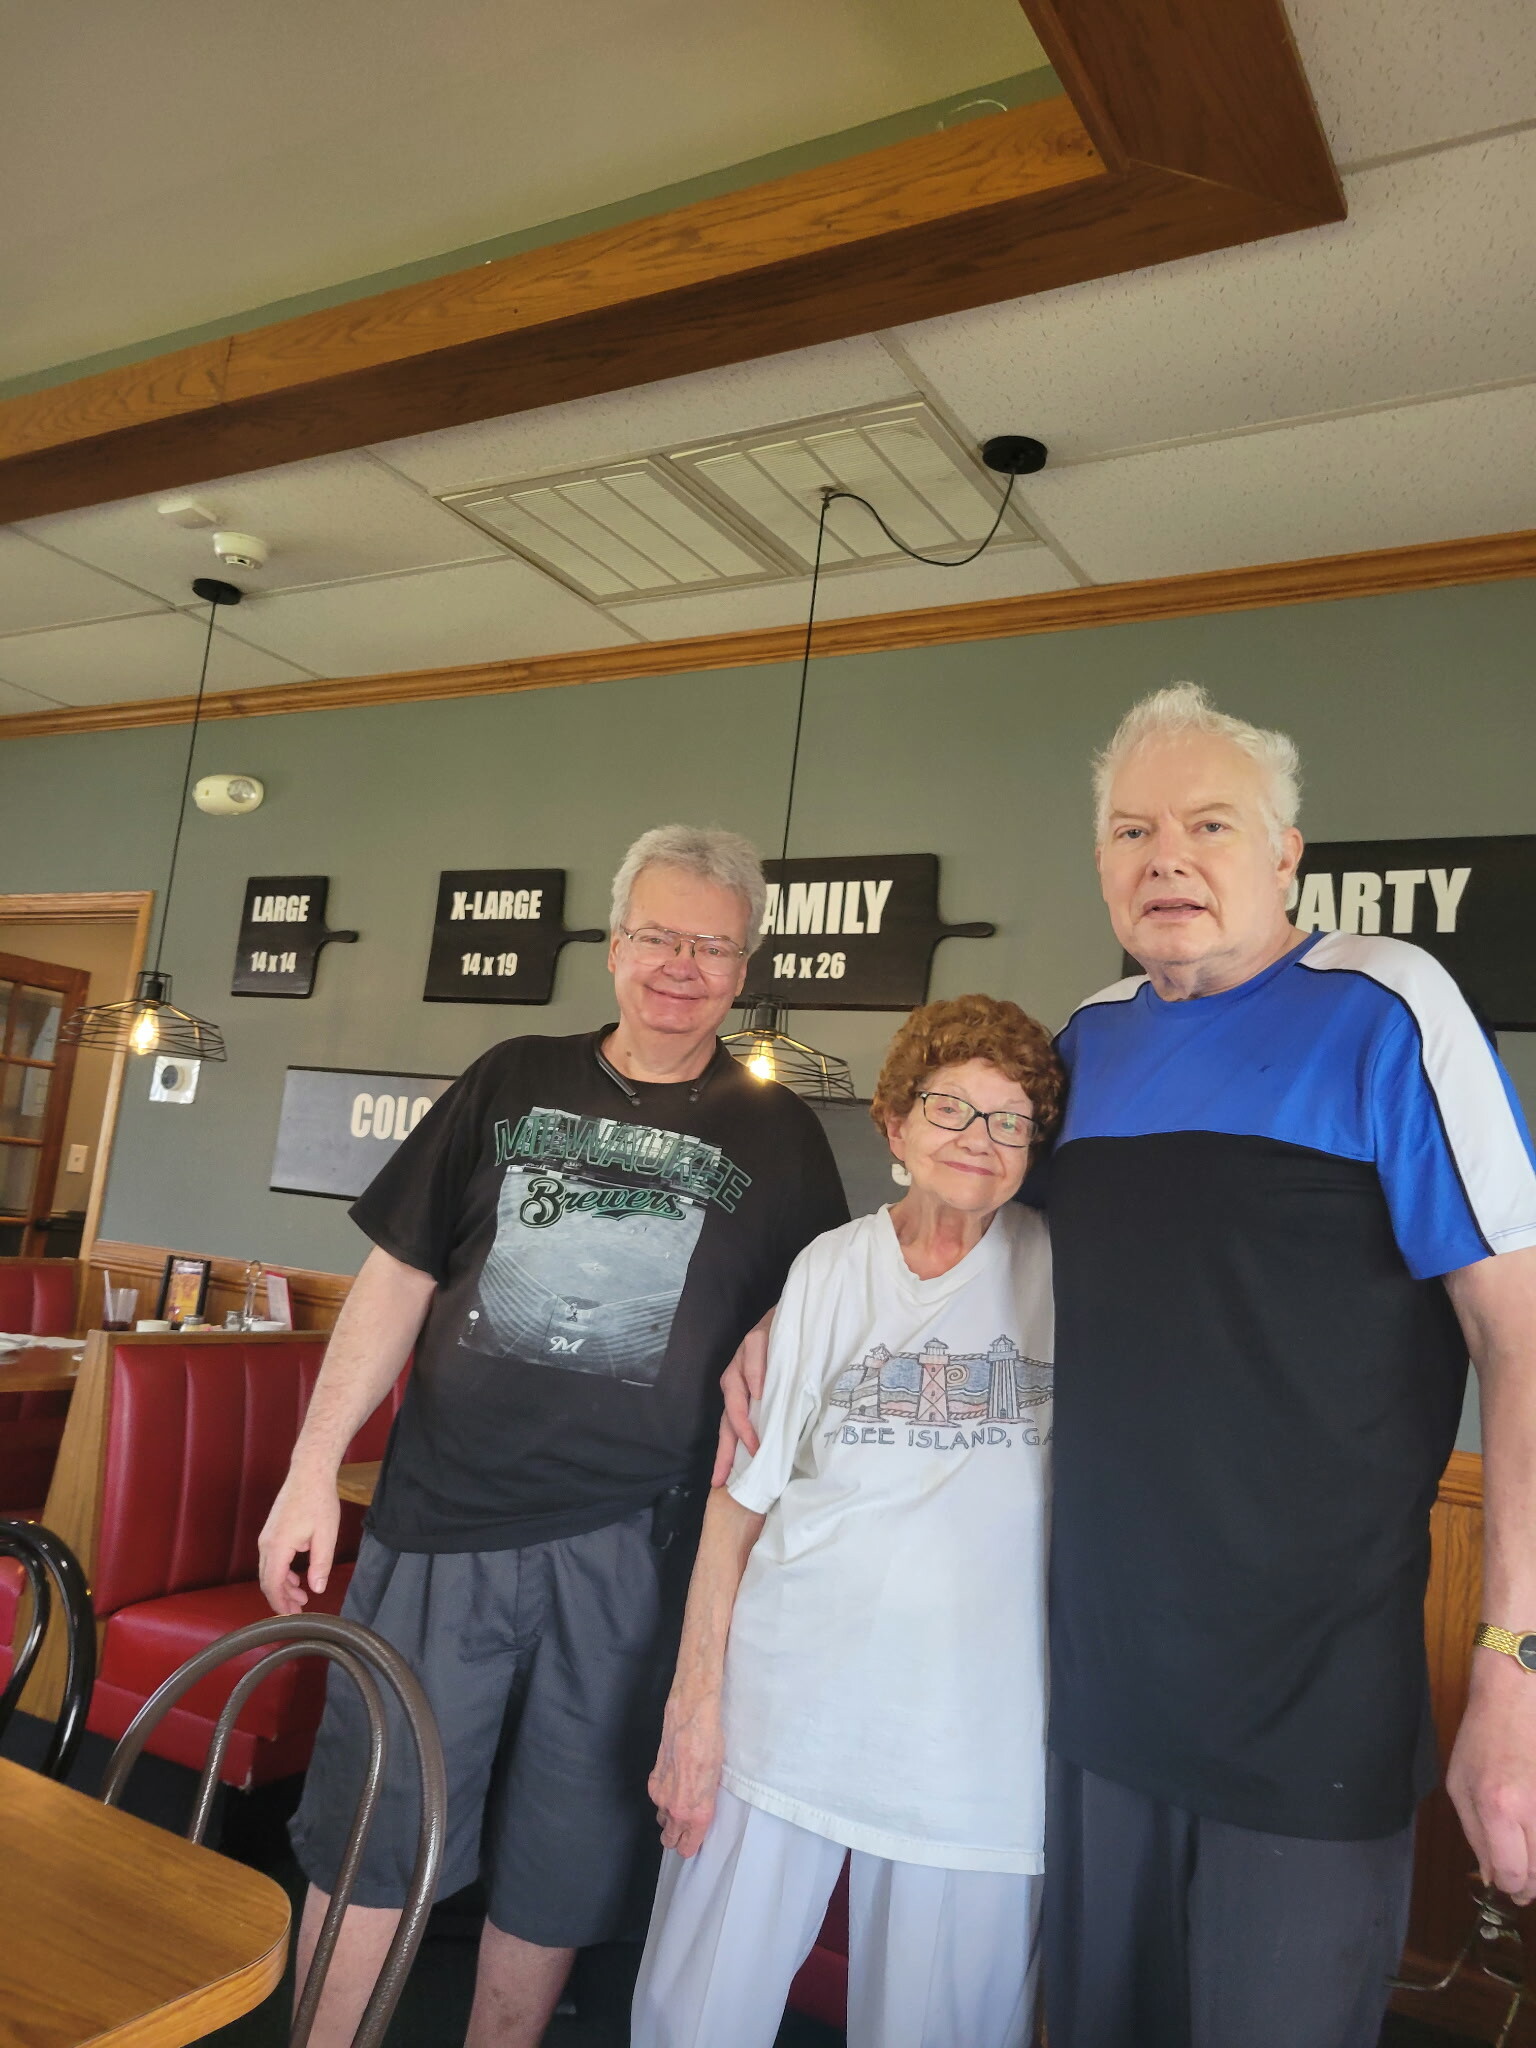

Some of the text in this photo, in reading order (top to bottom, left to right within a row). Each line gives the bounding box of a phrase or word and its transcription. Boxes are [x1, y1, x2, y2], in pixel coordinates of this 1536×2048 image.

[251, 895, 310, 922] LARGE
[450, 889, 543, 920] X-LARGE
[758, 880, 893, 935] AMILY
[251, 951, 268, 972] 14
[280, 952, 297, 973] 14
[461, 952, 481, 976] 14
[496, 952, 518, 976] 19
[773, 953, 797, 979] 14
[815, 952, 847, 980] 26
[350, 1092, 434, 1141] COLO
[494, 1112, 752, 1214] MILWAUKEE
[519, 1177, 687, 1229] Brewers
[908, 1426, 1012, 1450] ISLAND,
